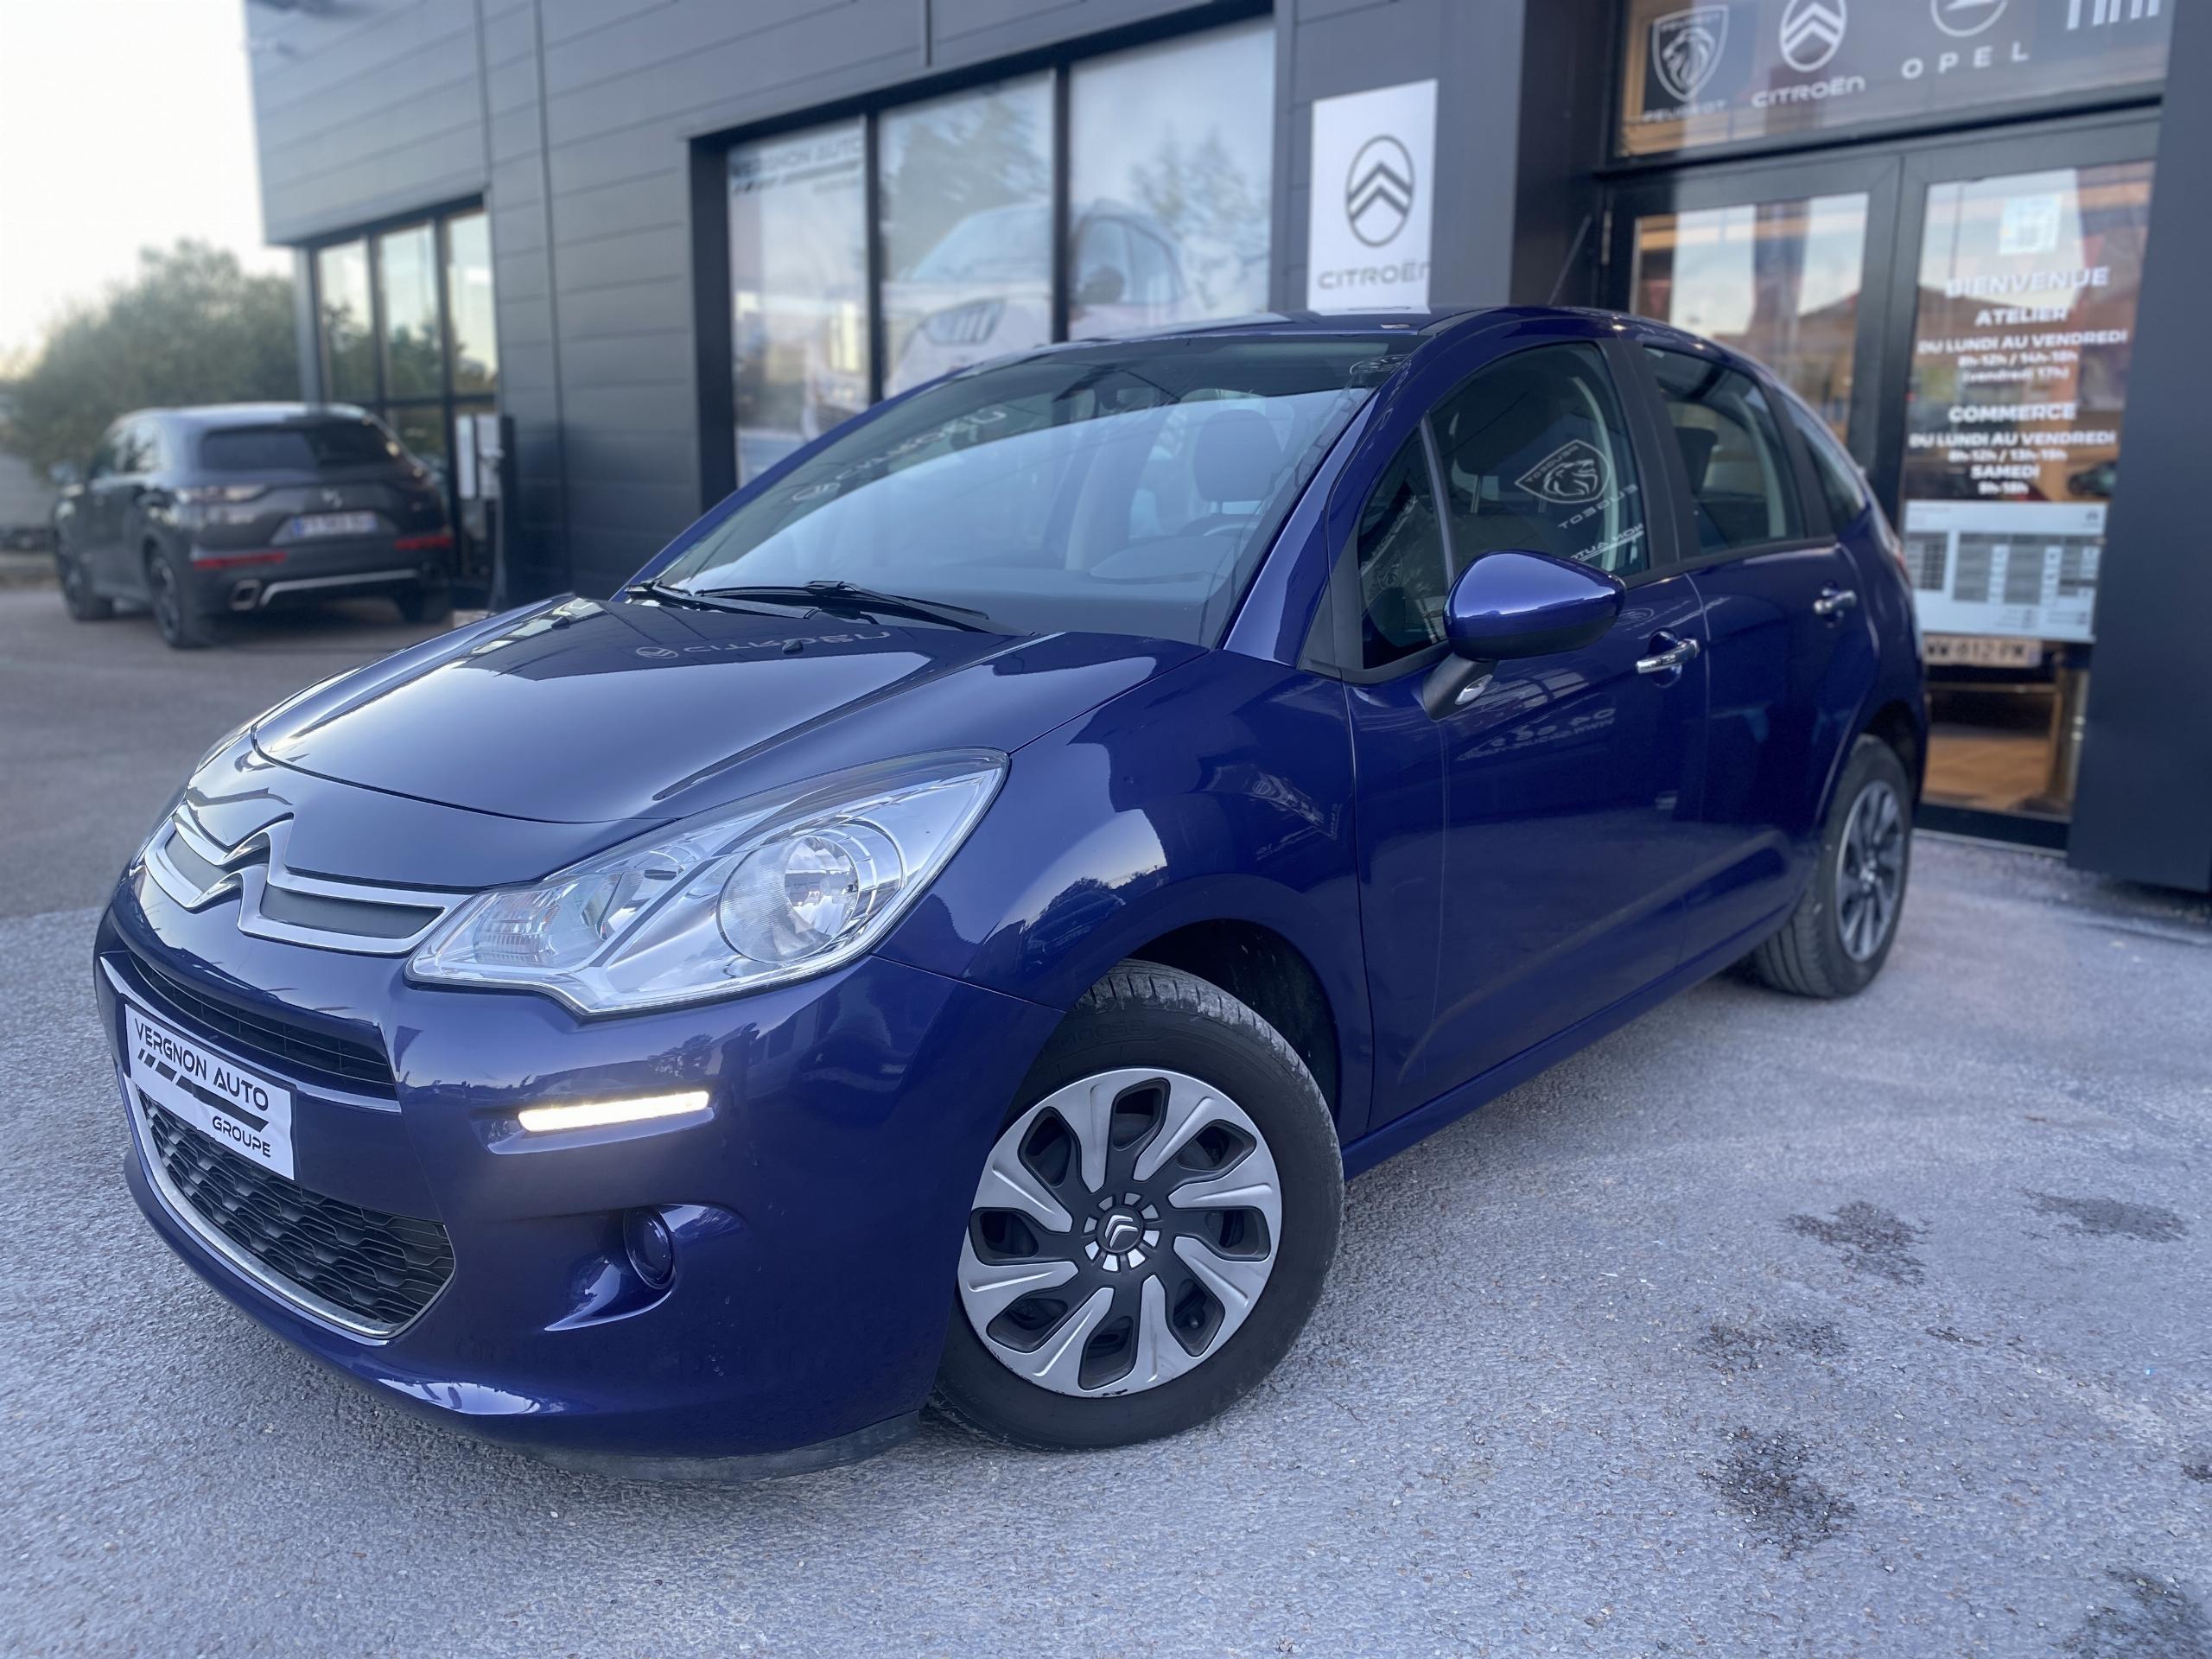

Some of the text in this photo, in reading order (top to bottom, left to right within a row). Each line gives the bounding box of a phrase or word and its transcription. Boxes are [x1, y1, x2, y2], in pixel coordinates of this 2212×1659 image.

[1901, 41, 2030, 79] OPEL
[1944, 266, 2109, 297] BIENVENUE
[1975, 306, 2069, 327] ATELIER
[1946, 336, 1999, 353] LUNDI
[2001, 334, 2028, 350] AU
[2031, 329, 2128, 347] VENDREDI
[1948, 402, 2077, 423] COMMERCE
[1936, 432, 1989, 447] LUNDI
[1991, 431, 2018, 446] AU
[2021, 430, 2116, 446] VENDREDI
[1970, 464, 2040, 480] SAMEDI
[135, 1018, 269, 1112] VERGNON AUTO
[213, 1116, 270, 1158] GROUPE
